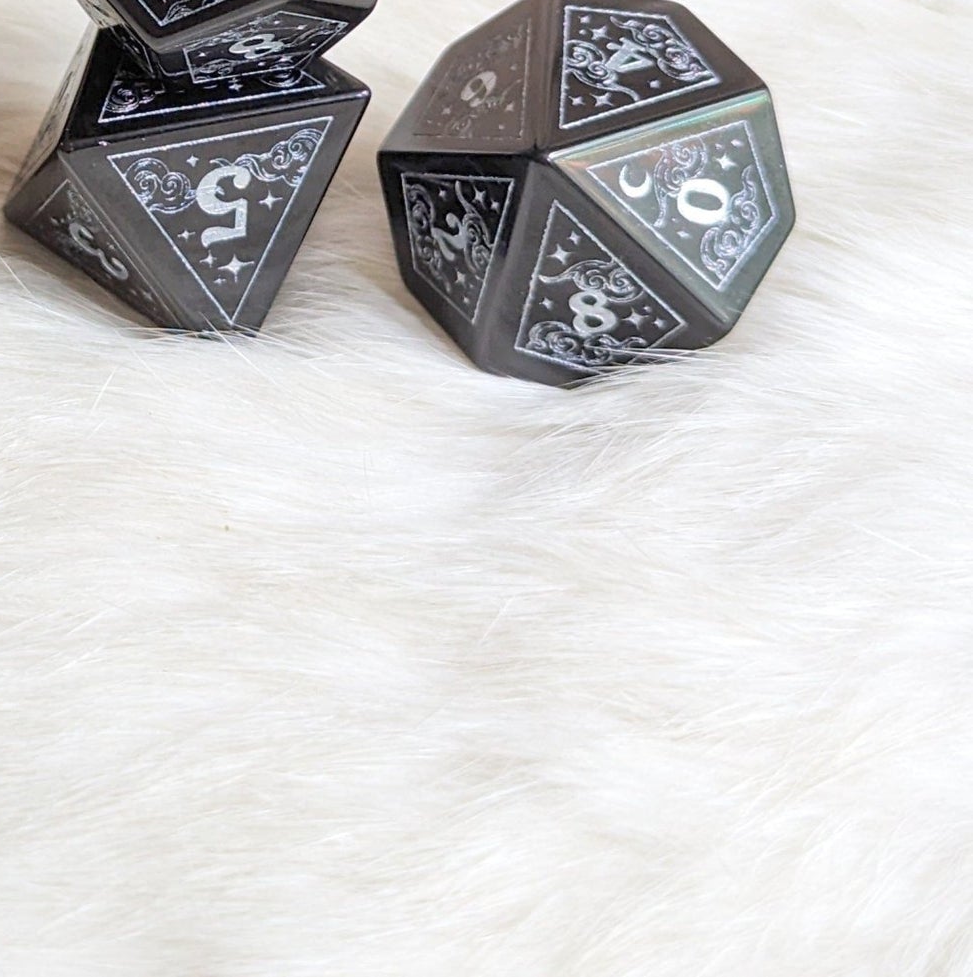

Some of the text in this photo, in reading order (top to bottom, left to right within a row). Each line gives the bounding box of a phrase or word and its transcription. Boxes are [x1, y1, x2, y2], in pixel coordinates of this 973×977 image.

[229, 33, 285, 59] 8
[195, 164, 251, 248] 5
[677, 177, 730, 225] 0
[568, 289, 619, 336] 8
